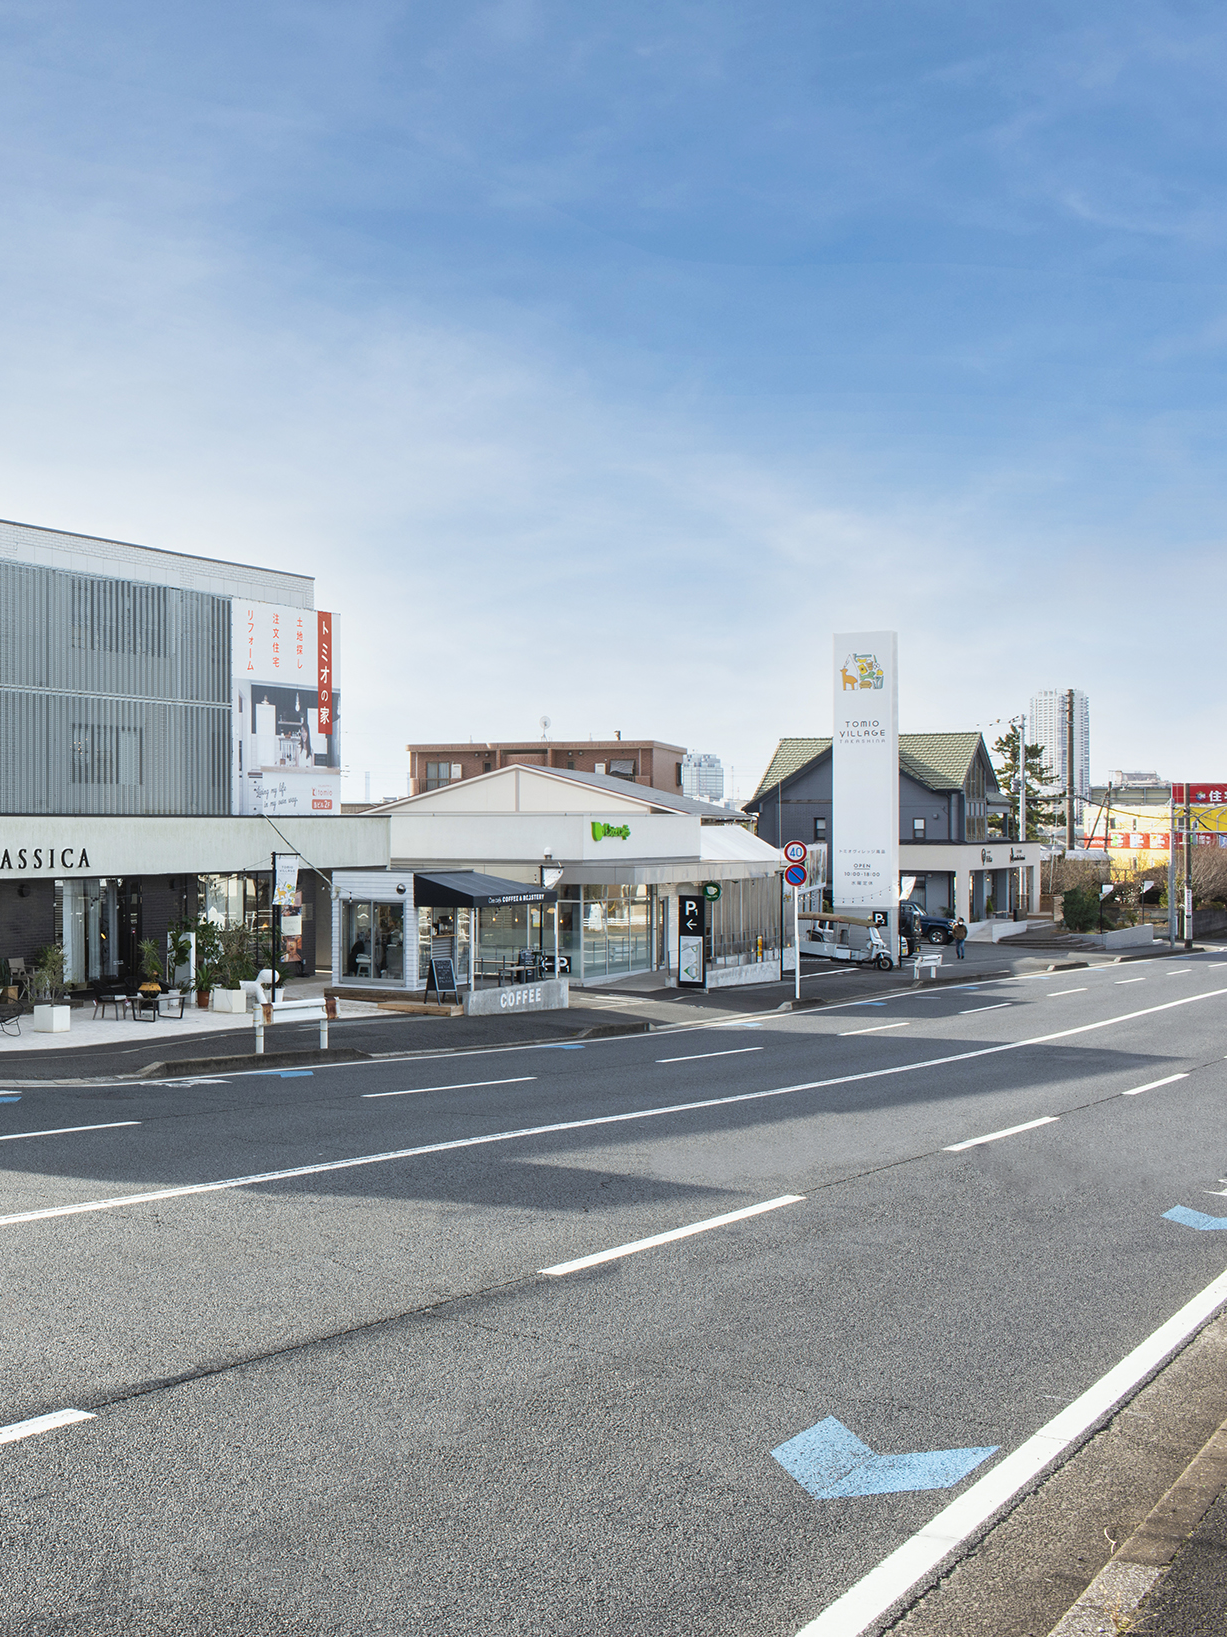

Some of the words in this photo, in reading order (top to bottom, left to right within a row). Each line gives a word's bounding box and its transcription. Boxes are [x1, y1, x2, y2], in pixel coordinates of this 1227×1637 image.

[246, 609, 255, 671] リフォーム
[272, 612, 280, 668] 注文住宅
[319, 620, 330, 725] トミオの家
[845, 720, 880, 728] TOMIO
[839, 729, 886, 738] VILLAGE
[317, 789, 333, 797] tomio
[789, 847, 803, 858] 40
[500, 987, 542, 1009] COFFEE
